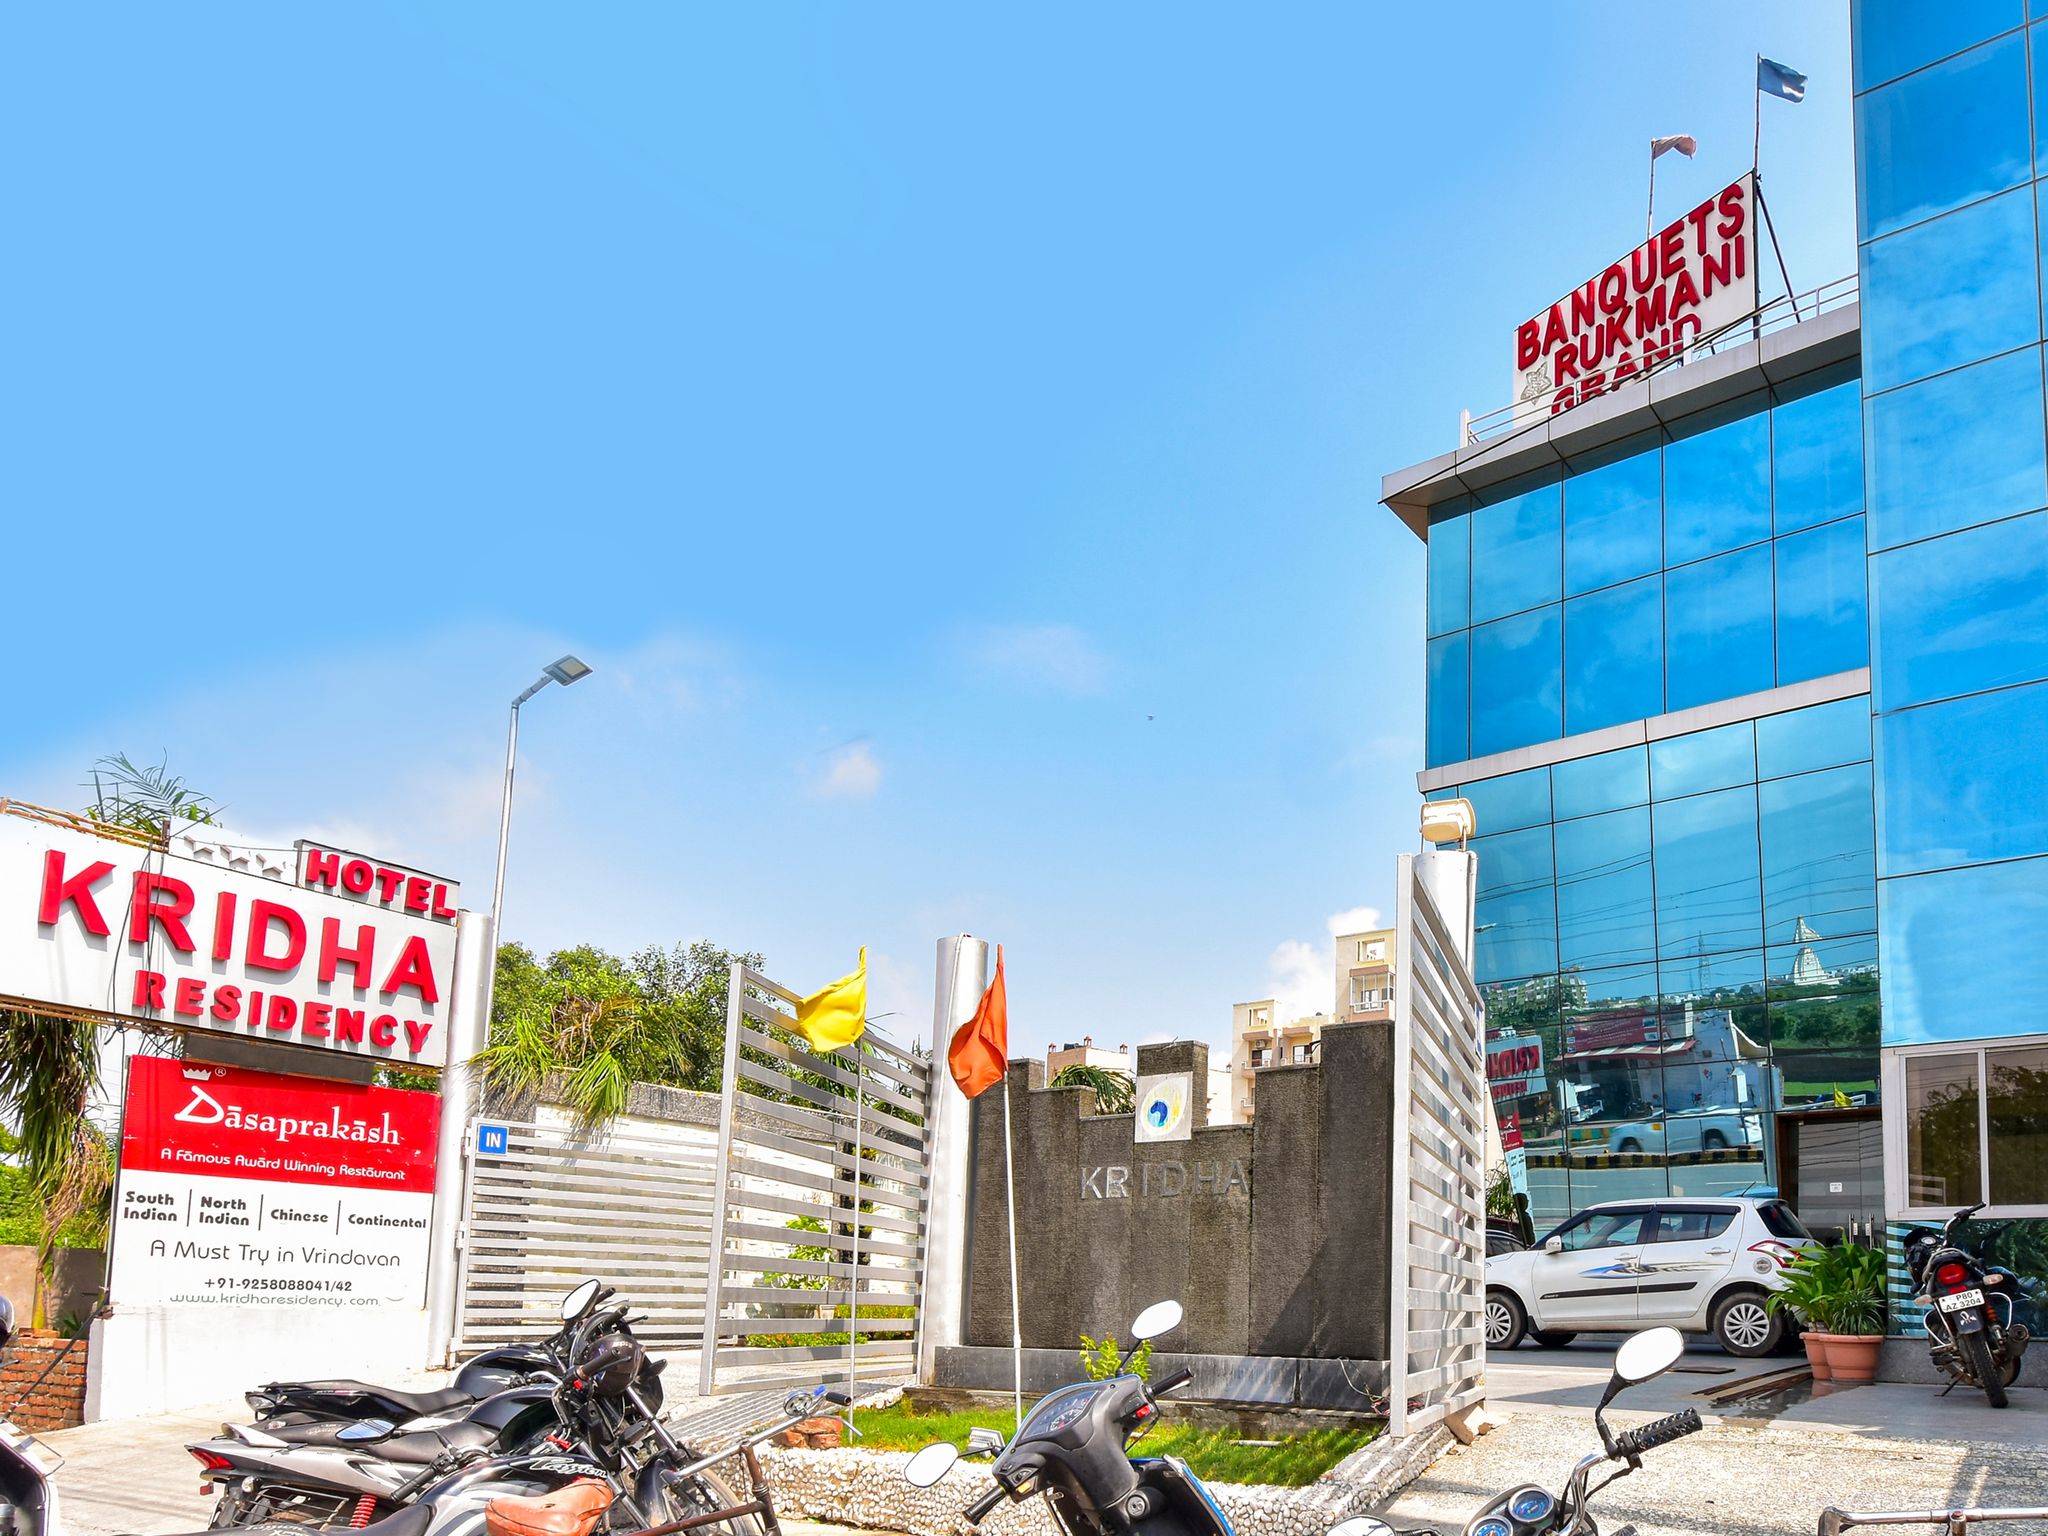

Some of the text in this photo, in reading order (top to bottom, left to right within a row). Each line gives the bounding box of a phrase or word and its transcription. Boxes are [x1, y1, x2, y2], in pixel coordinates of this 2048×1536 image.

[1518, 183, 1745, 371] BANQUETS
[1554, 234, 1745, 388] RUKMANI
[306, 848, 457, 920] HOTEL
[39, 849, 439, 1005] KRIDHA
[133, 969, 433, 1054] RESIDENCY
[485, 1131, 502, 1148] IN
[161, 1147, 172, 1160] A
[283, 1159, 336, 1177] Winning
[1080, 1159, 1250, 1200] KRIDHA
[125, 1190, 175, 1206] South
[200, 1195, 247, 1211] North
[123, 1206, 178, 1222] Indian
[199, 1211, 250, 1226] Indian
[270, 1208, 329, 1223] Chinese
[347, 1213, 427, 1229] Continental
[150, 1239, 400, 1267] A Must Try in Vrindavan
[204, 1277, 352, 1293] +91-9258088041/42
